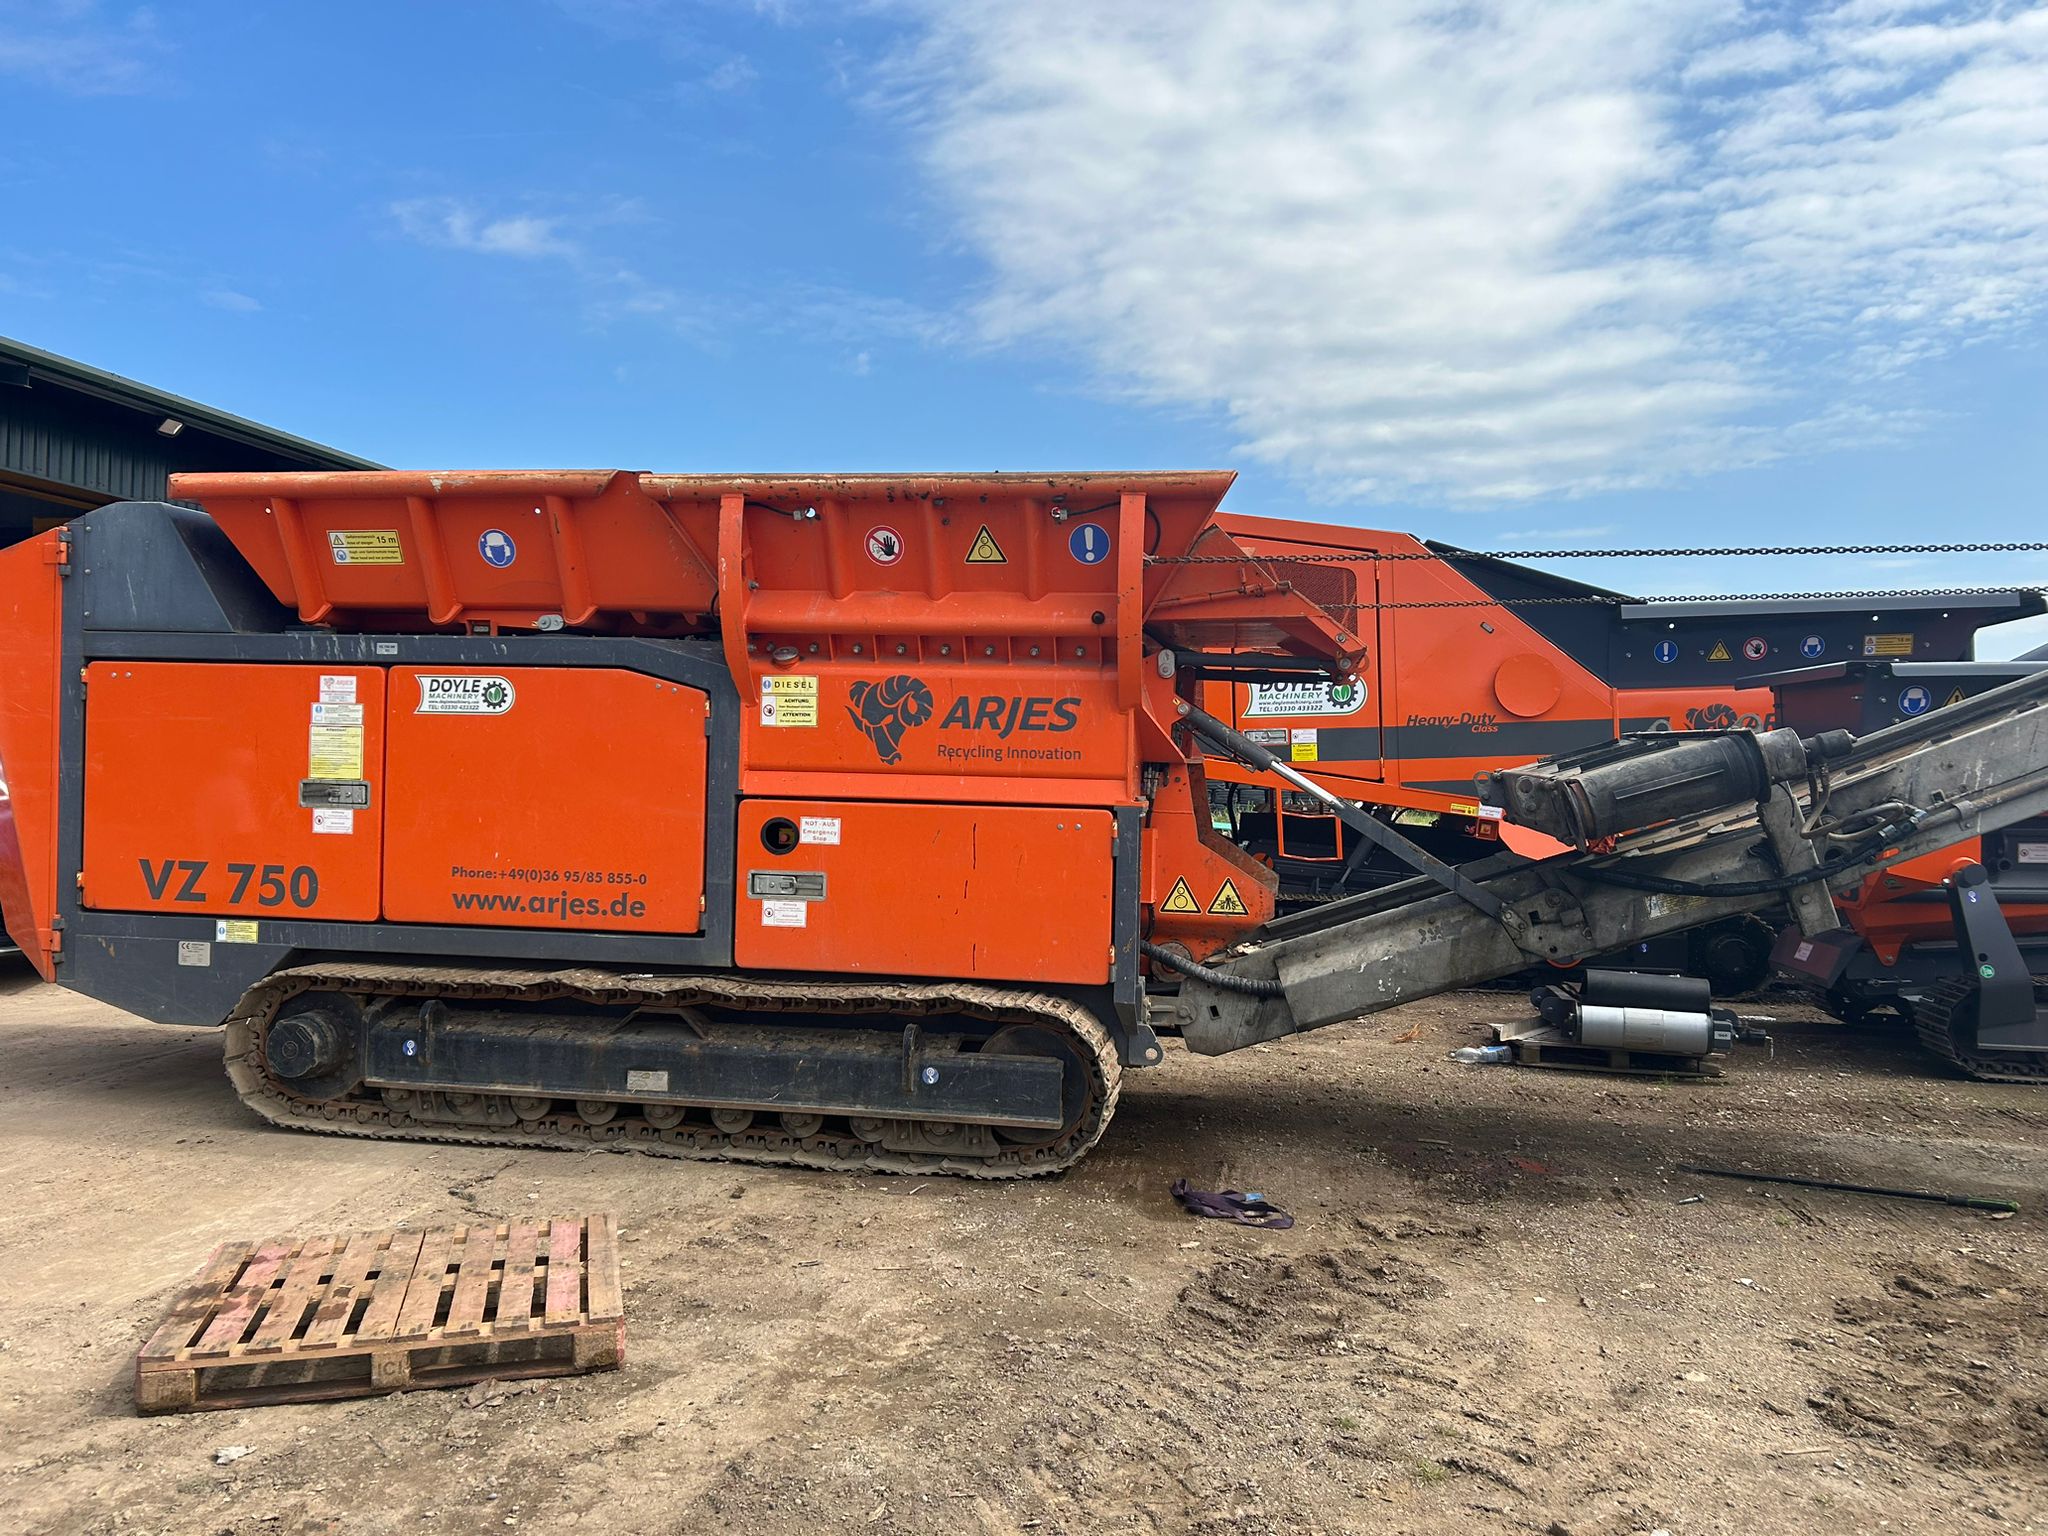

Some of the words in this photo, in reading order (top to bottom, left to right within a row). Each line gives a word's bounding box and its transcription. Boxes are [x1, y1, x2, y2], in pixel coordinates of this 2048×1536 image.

[376, 536, 386, 544] 15
[429, 679, 481, 692] DOYLE
[939, 696, 1082, 739] ARJES
[1407, 712, 1496, 728] Heavy-Duty
[937, 744, 1002, 762] Recycling
[1007, 746, 1081, 760] Innovation
[138, 859, 208, 902] VZ
[228, 864, 318, 908] 750
[564, 871, 603, 884] 95/85
[607, 873, 647, 885] 855-0
[452, 891, 646, 920] www.arjes.de
